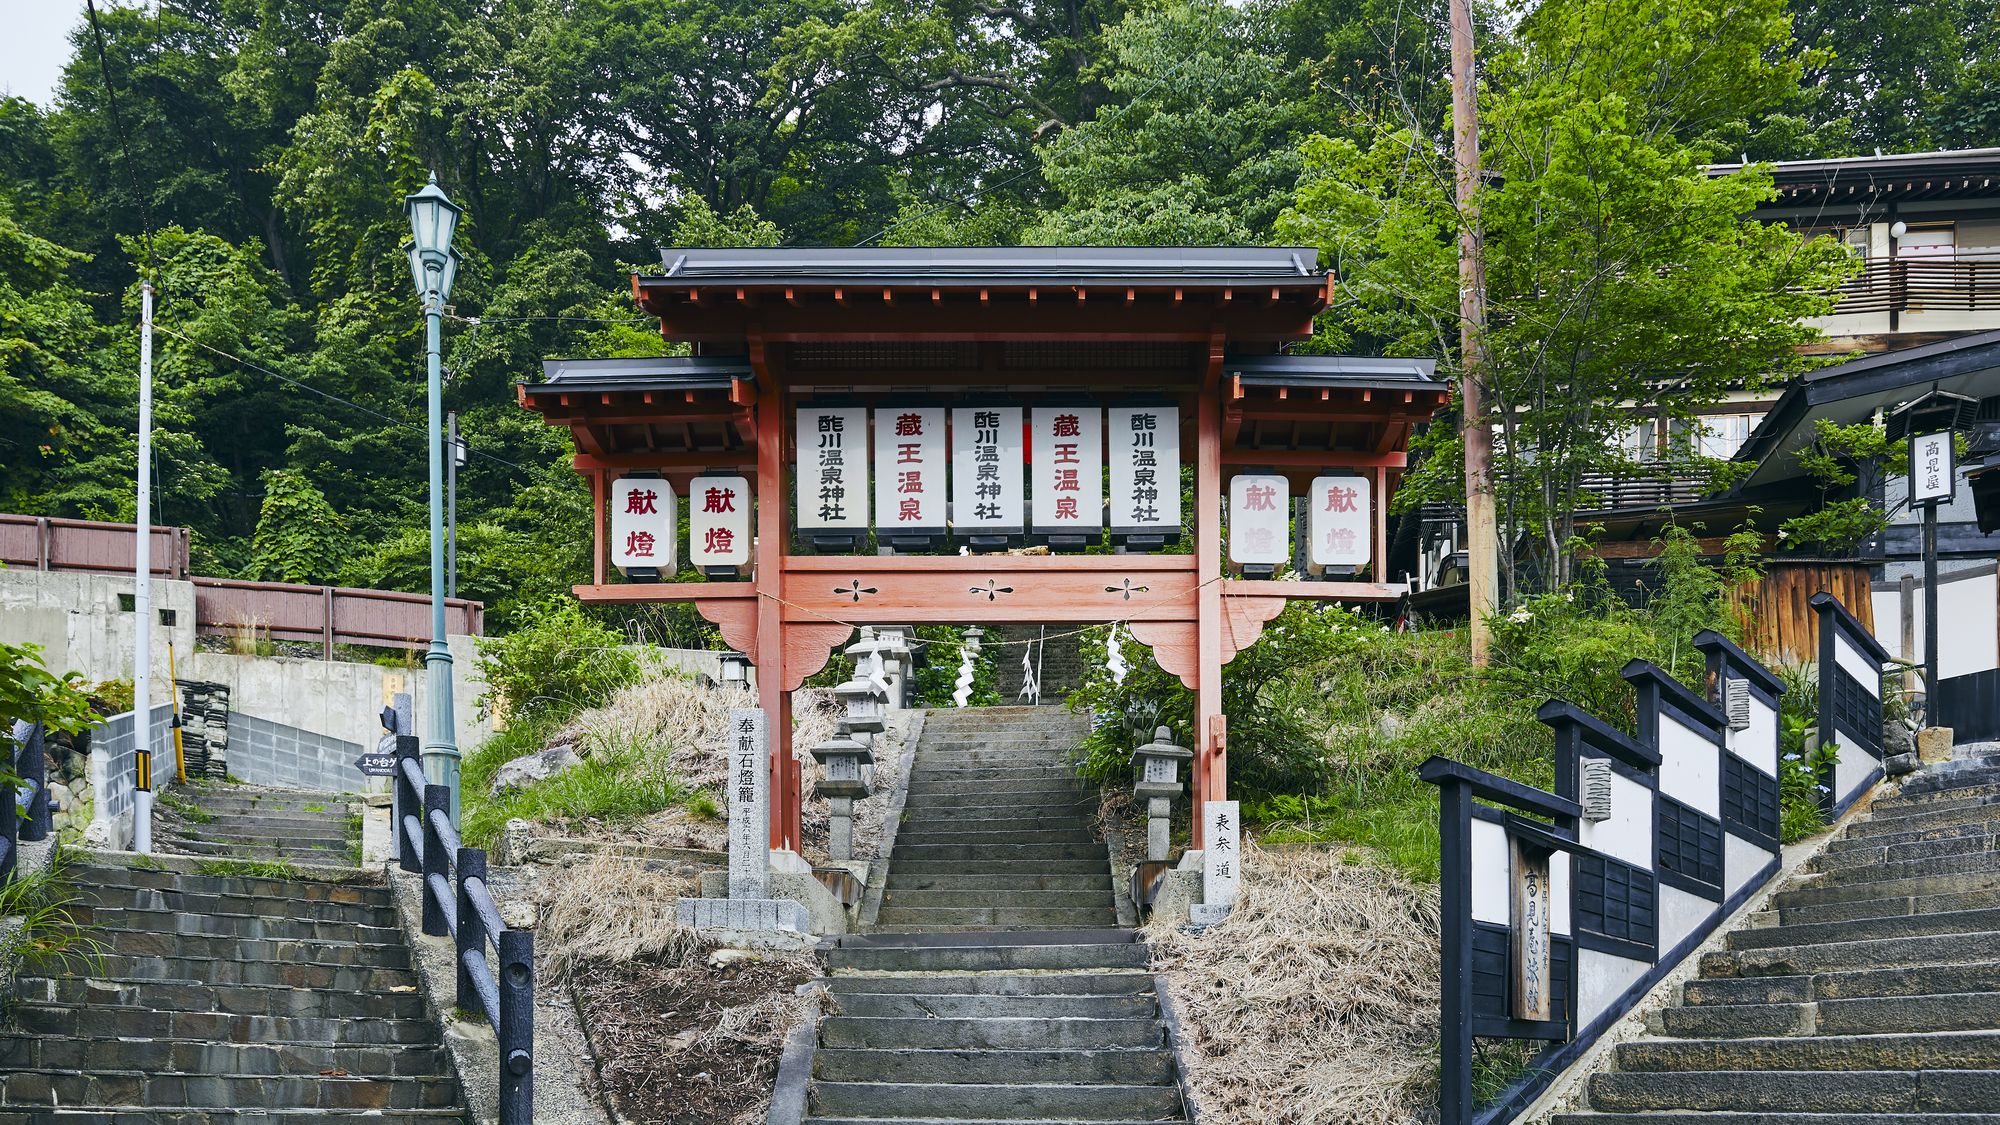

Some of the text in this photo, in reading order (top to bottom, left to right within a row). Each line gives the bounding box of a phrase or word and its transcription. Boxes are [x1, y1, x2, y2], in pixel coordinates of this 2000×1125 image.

[817, 414, 847, 522] 酢川温泉神社
[894, 413, 924, 522] 蔵王温泉
[973, 411, 1003, 521] 酢川温泉神社
[1052, 413, 1082, 520] 蔵王温泉
[1130, 413, 1160, 523] 酢川温泉神社
[624, 487, 658, 558] 献燈
[702, 486, 736, 554] 献燈
[1323, 486, 1358, 555] 献燈
[737, 718, 755, 803] 奉献石燈籠
[1215, 813, 1232, 879] 表参道
